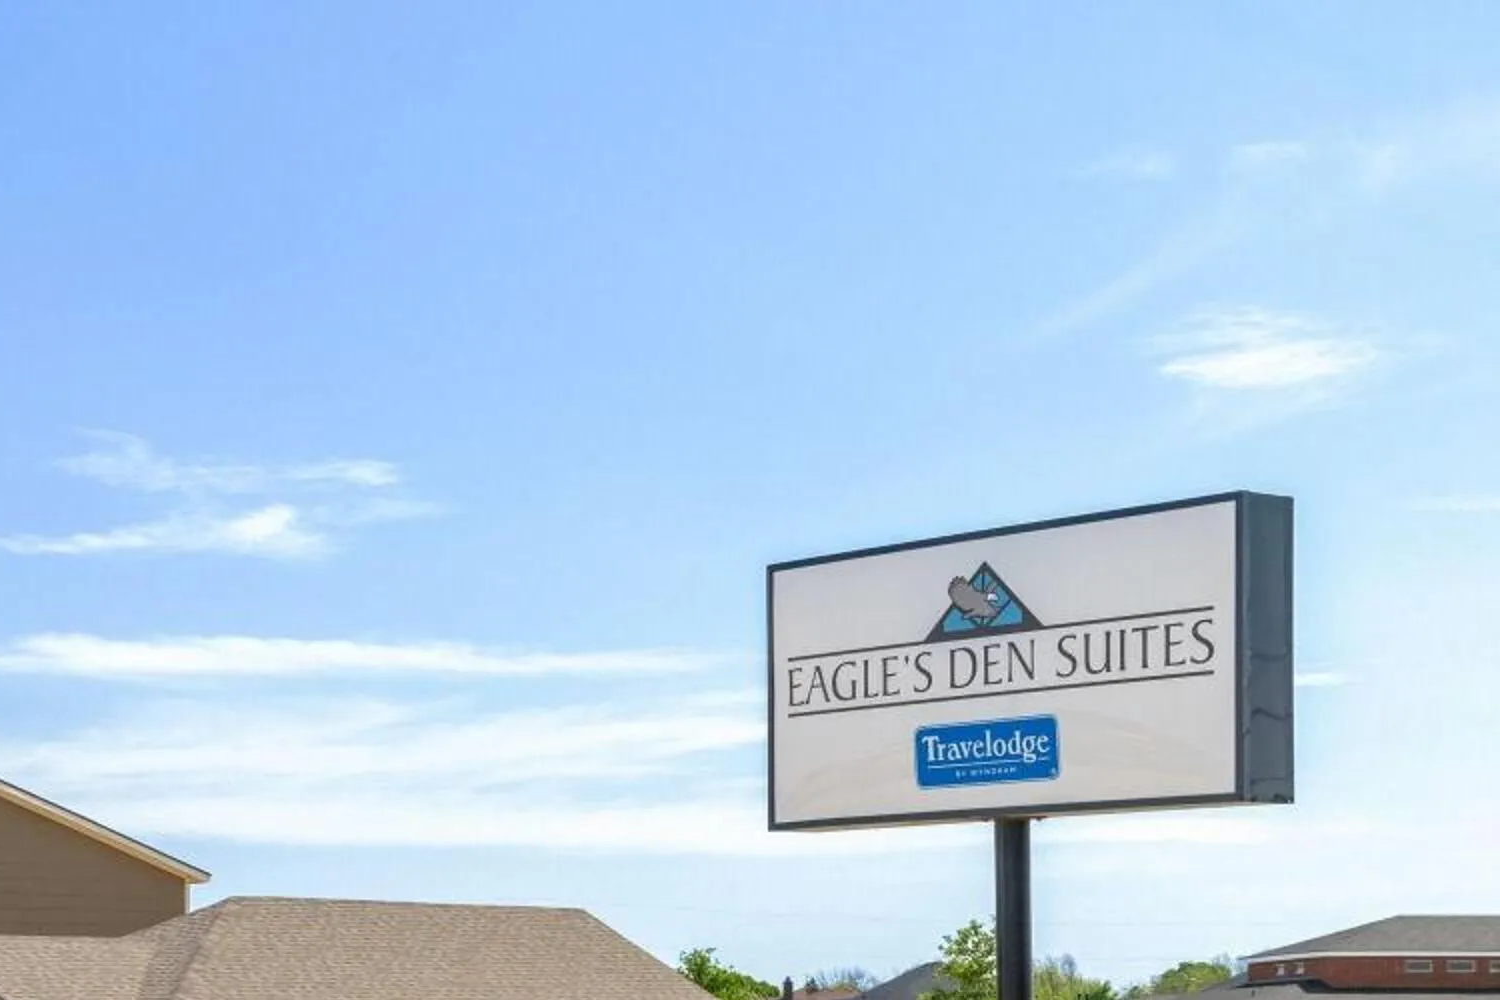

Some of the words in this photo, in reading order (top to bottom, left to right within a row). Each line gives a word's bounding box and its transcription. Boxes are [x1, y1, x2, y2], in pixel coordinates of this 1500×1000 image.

[788, 651, 933, 706] EAGLE'S
[949, 639, 1035, 689] DEN
[1056, 618, 1215, 678] SUITES
[921, 728, 1050, 763] Travelodge
